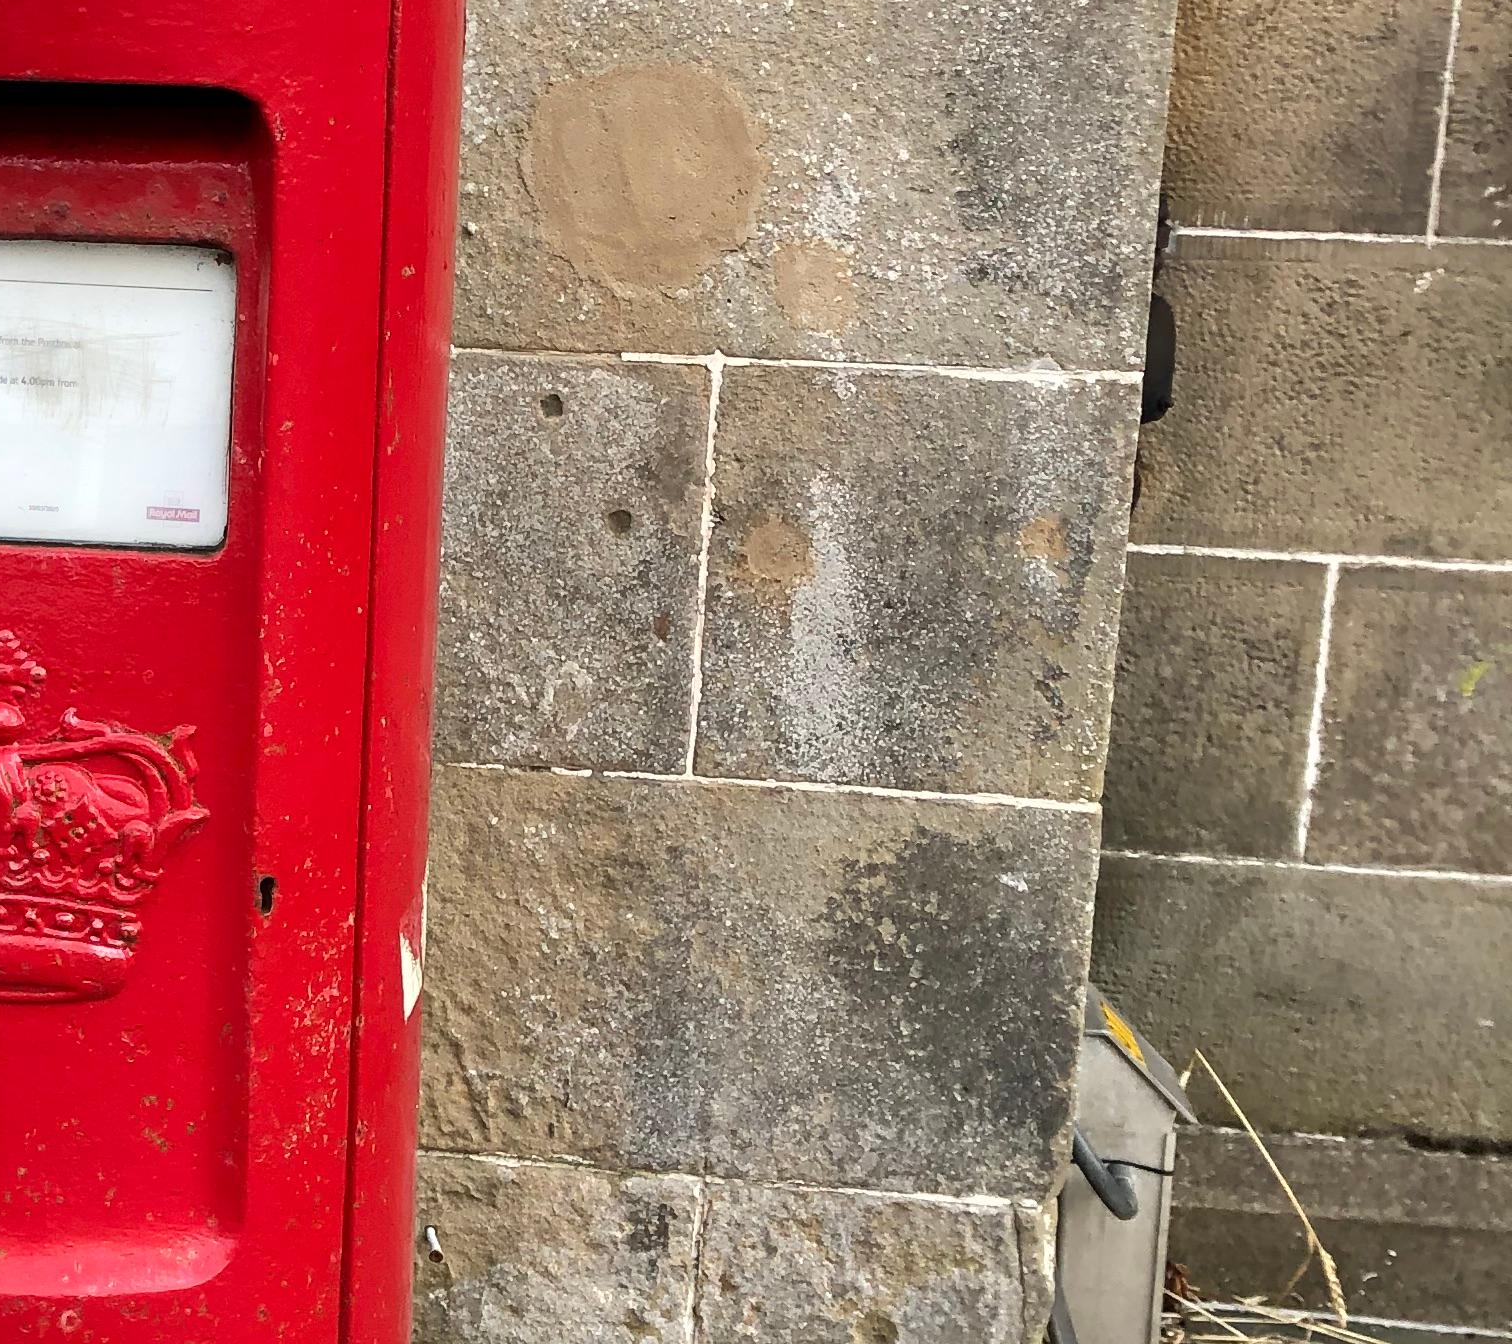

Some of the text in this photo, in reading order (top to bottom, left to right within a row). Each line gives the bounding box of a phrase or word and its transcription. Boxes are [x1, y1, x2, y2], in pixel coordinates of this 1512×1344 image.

[0, 336, 19, 346] from
[22, 337, 36, 346] the
[21, 375, 56, 389] 4.00pm
[149, 508, 198, 521] Royal Mail
